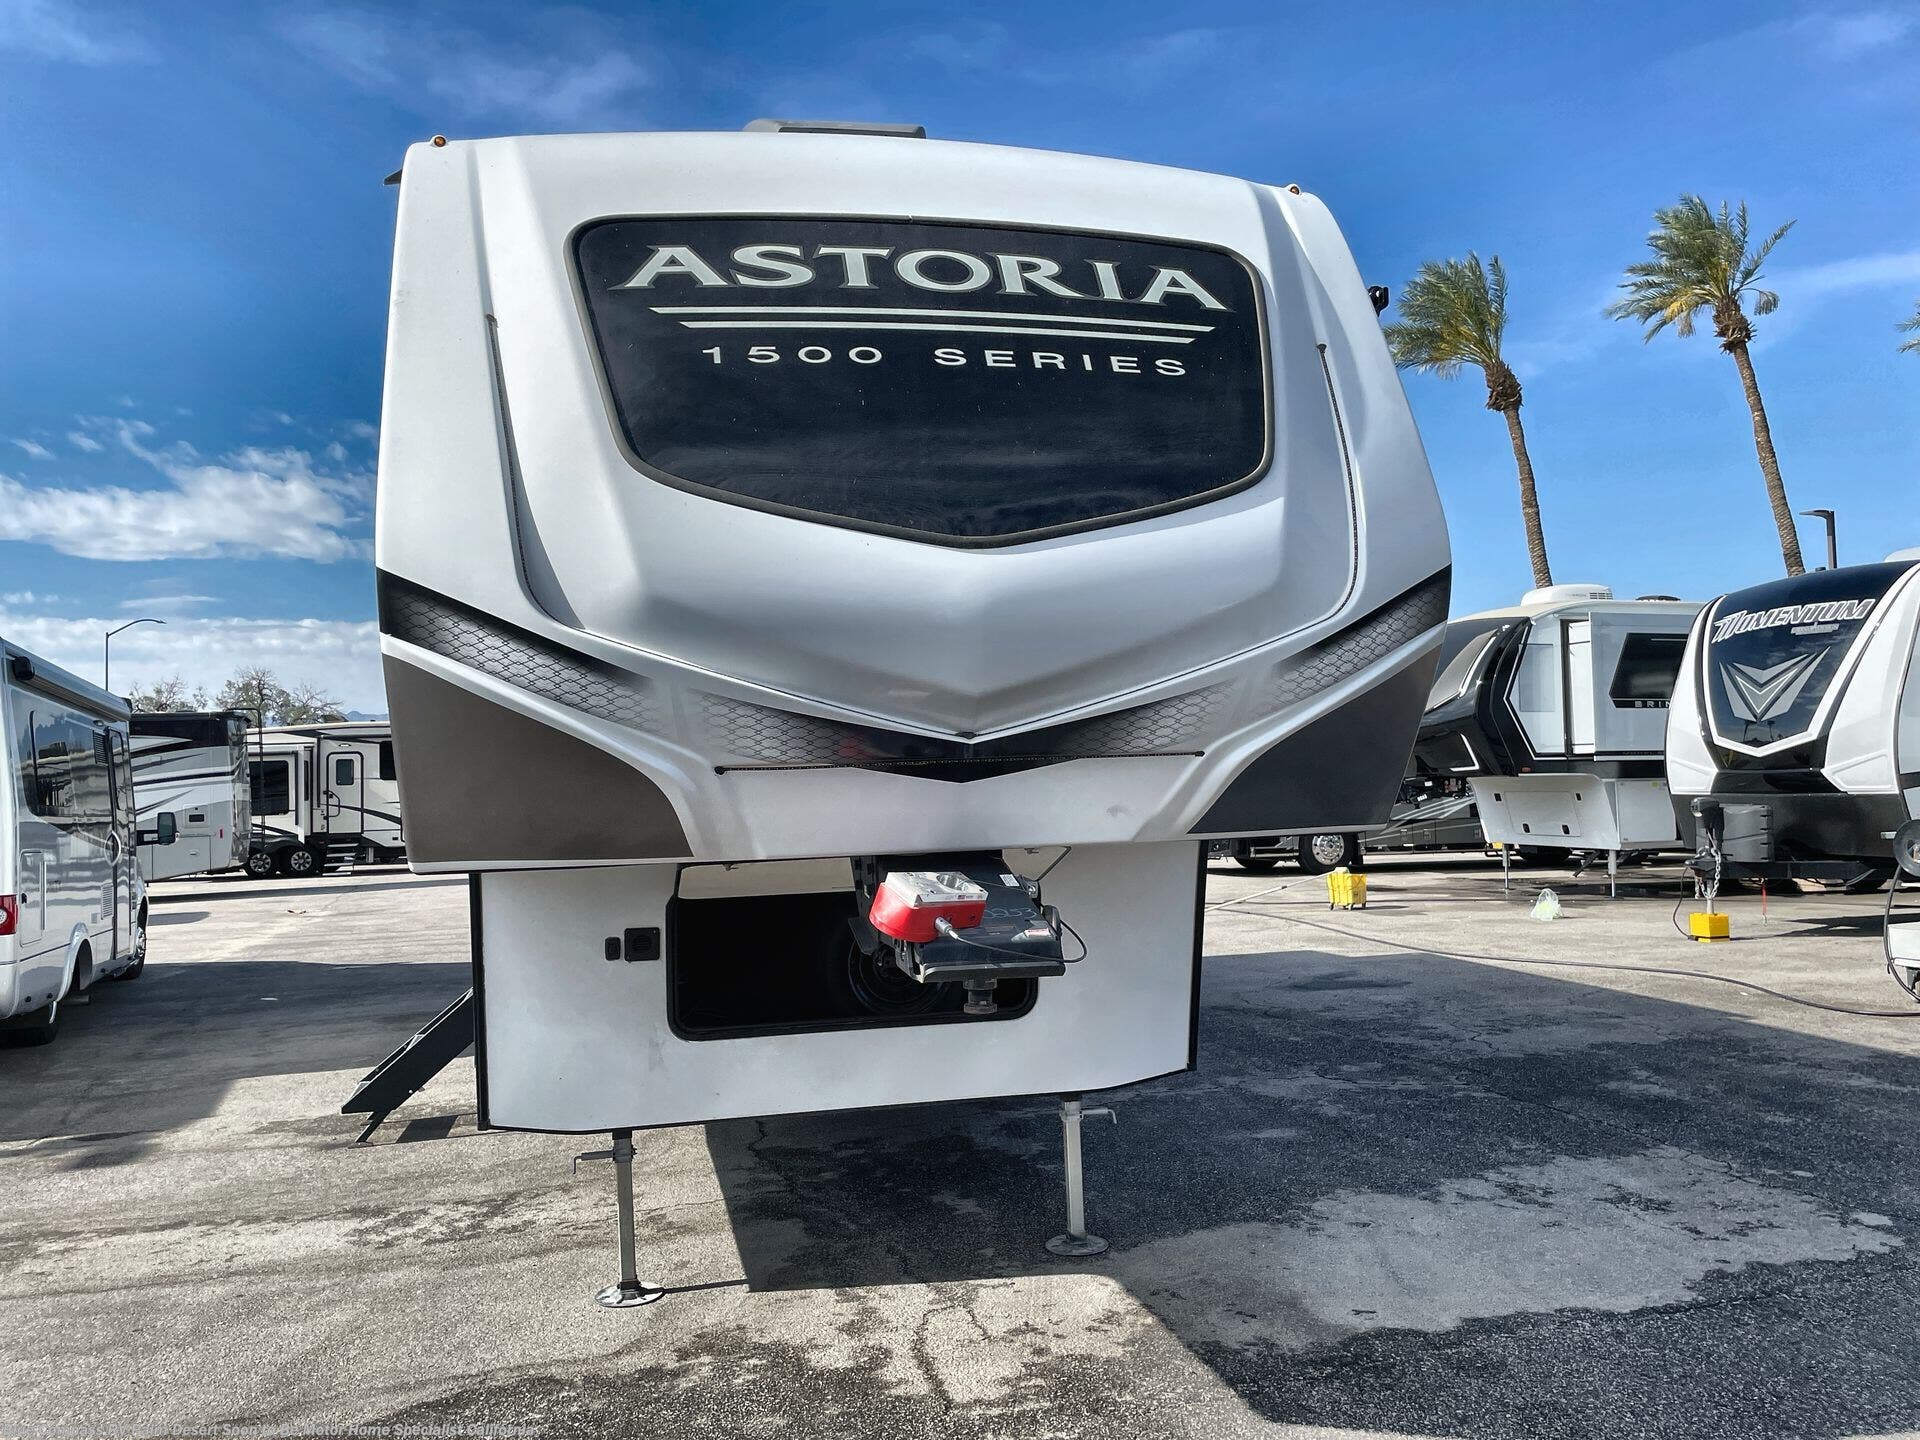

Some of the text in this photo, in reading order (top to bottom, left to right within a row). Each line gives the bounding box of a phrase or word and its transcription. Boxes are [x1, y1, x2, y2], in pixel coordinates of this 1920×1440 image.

[622, 244, 1228, 312] ASTORIA
[702, 346, 1188, 377] 1500 SERIES
[1711, 599, 1877, 644] MOMENTUM
